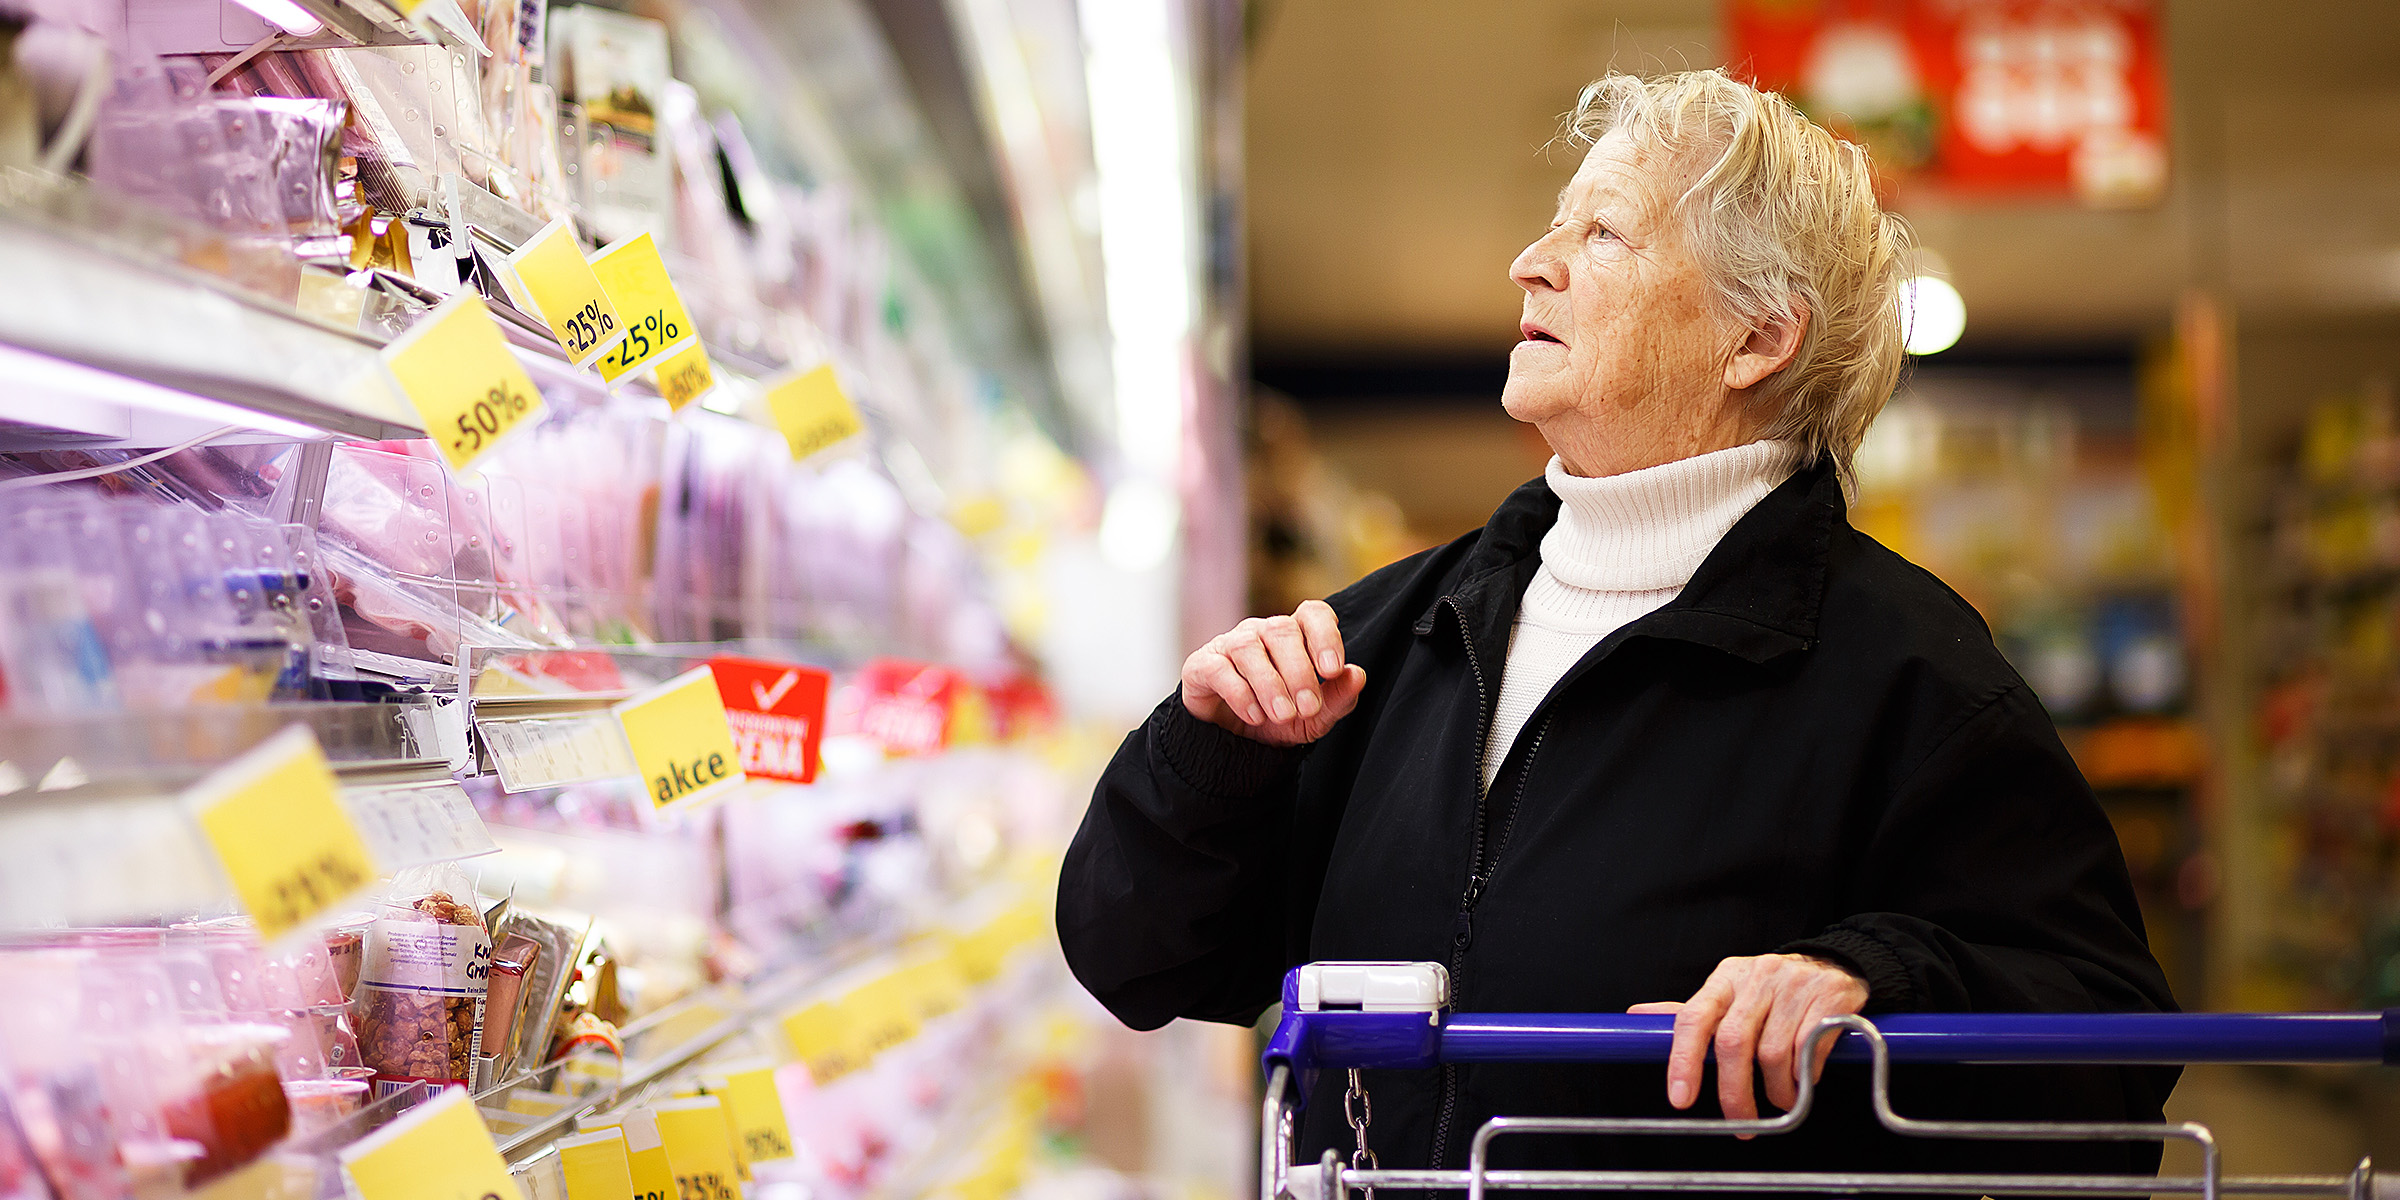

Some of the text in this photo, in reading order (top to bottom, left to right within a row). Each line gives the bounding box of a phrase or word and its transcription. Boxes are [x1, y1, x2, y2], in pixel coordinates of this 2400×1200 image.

[567, 299, 614, 352] -25%
[607, 309, 678, 367] -25%
[454, 380, 527, 451] -50%
[655, 753, 726, 802] akce
